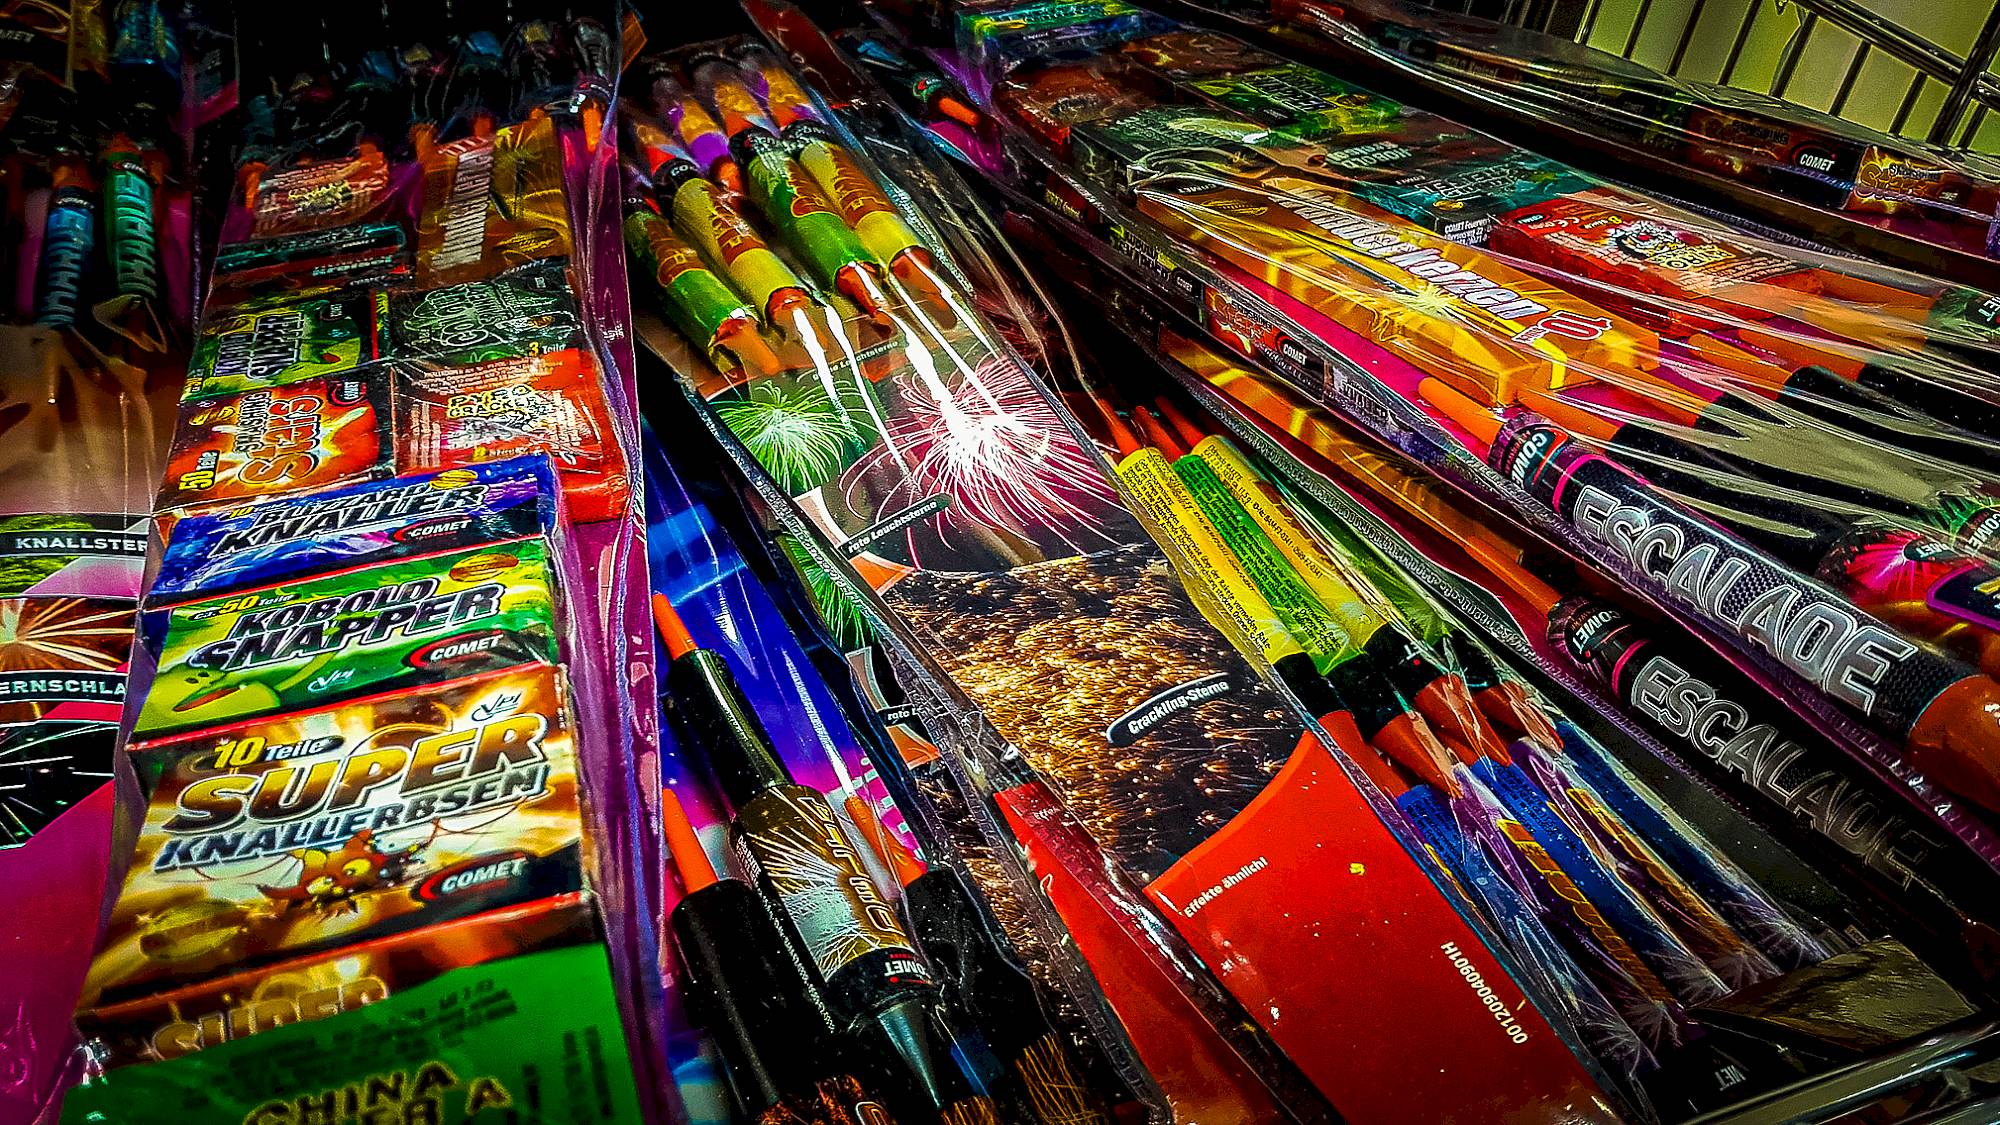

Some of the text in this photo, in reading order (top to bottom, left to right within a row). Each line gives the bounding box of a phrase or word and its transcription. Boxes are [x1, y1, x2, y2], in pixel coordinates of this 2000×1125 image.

[1800, 153, 1836, 172] COMET
[1266, 178, 1549, 320] Wunderkerzen
[528, 341, 540, 357] 3
[1538, 311, 1612, 341] 10
[840, 341, 898, 369] Lechtsterne
[1283, 342, 1308, 366] COMET
[236, 390, 270, 452] SMASHING
[178, 466, 217, 492] 50
[1510, 431, 1549, 489] COME
[208, 484, 491, 558] KNALLER
[410, 519, 472, 538] COMET
[848, 499, 940, 554] rote Leuchtsterne
[190, 583, 506, 673] SNAPPER
[220, 595, 257, 614] 50
[228, 577, 441, 641] KOBOLD
[1571, 484, 1920, 718] ESCALADE
[429, 634, 504, 661] COMET
[1570, 610, 1621, 656] COMET
[1127, 681, 1230, 735] Crackling-Sterne
[162, 713, 550, 835] SUPER
[213, 737, 326, 769] 10 Teile
[1631, 655, 1945, 892] ESCALADE
[152, 763, 552, 875] KNALLERBSEN
[440, 857, 527, 894] COMET
[1183, 856, 1268, 918] Effekte ähnlich!
[1440, 941, 1529, 1044] 001209040901H
